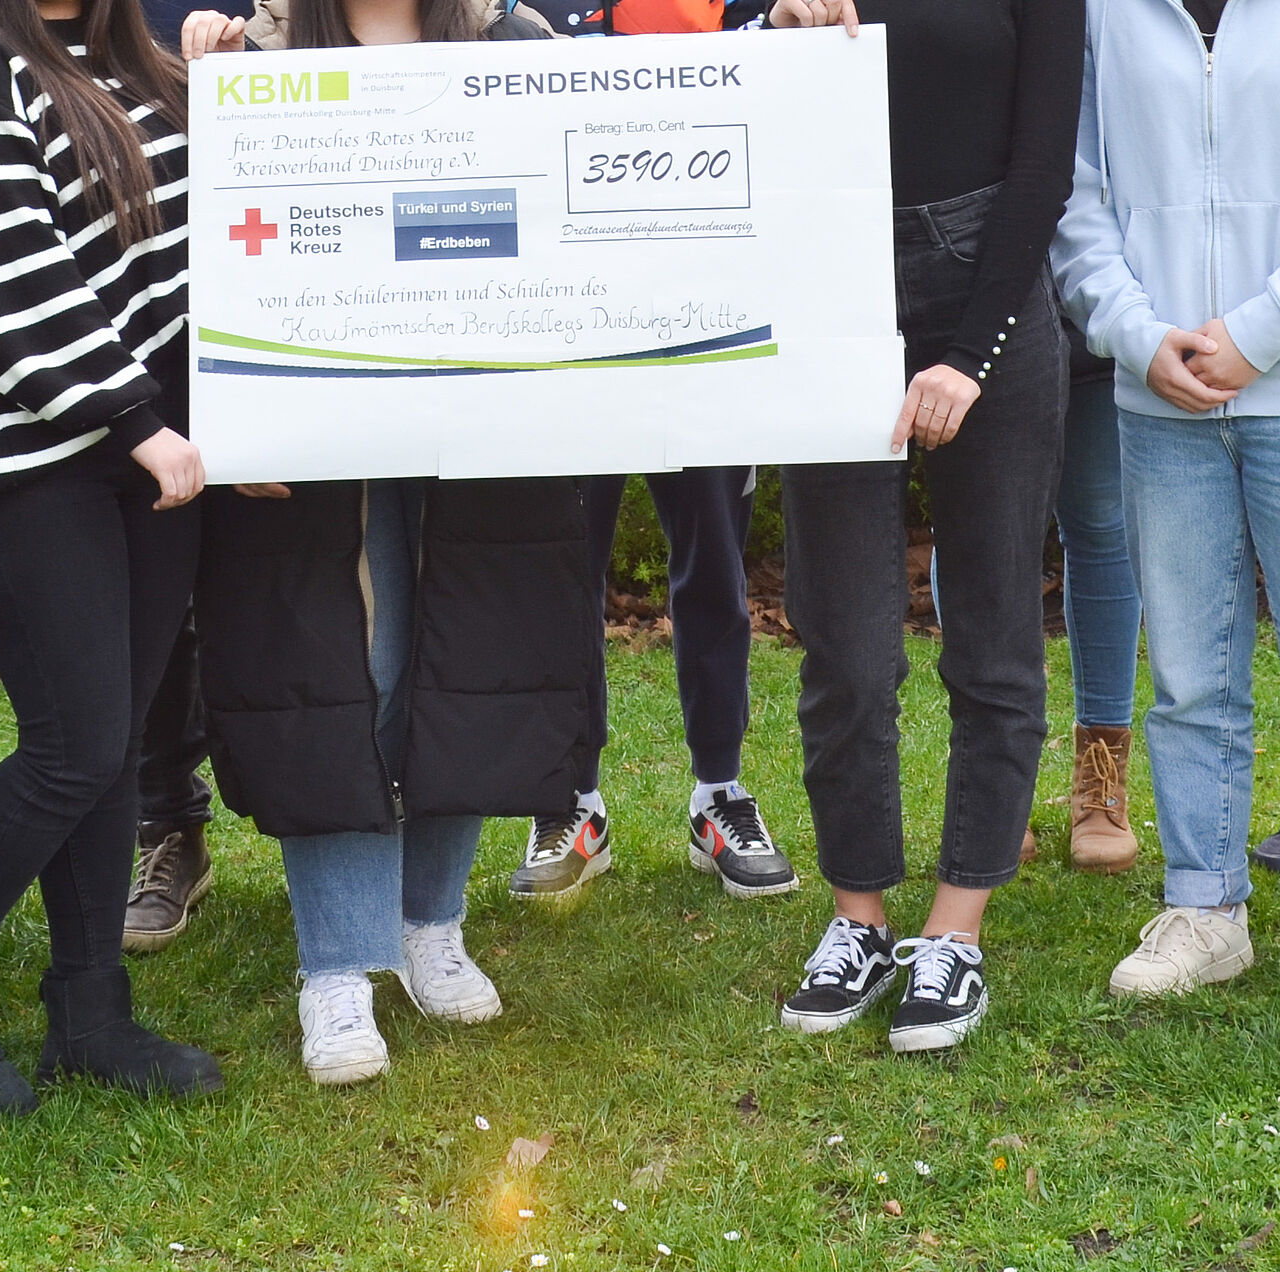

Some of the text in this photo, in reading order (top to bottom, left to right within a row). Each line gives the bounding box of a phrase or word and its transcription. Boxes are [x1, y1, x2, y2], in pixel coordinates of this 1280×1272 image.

[361, 70, 446, 80] Wirtschaftskompetenz
[463, 64, 742, 98] SPENDENSCHECK
[217, 72, 311, 106] KBM
[371, 83, 404, 92] Duisburg
[217, 107, 396, 122] Kaufmännisches Berufskolleg Duisburg-Mitte
[585, 123, 624, 135] Betrag:
[658, 120, 685, 132] Cent
[228, 128, 474, 160] für: Deutsches Rotes Kreuz
[233, 151, 480, 177] Kreisverband Duisburg e.V.
[289, 203, 384, 220] Deutsches
[398, 200, 513, 216] Türkei und Syrien
[290, 223, 341, 237] Rotes
[290, 241, 341, 255] Kreuz
[419, 236, 490, 250] #Erdbeben
[257, 277, 608, 309] von den Schülerinnen und Schülern des
[281, 301, 750, 344] Kaufmännischen Berufskollegs Duisburg-Mitte
